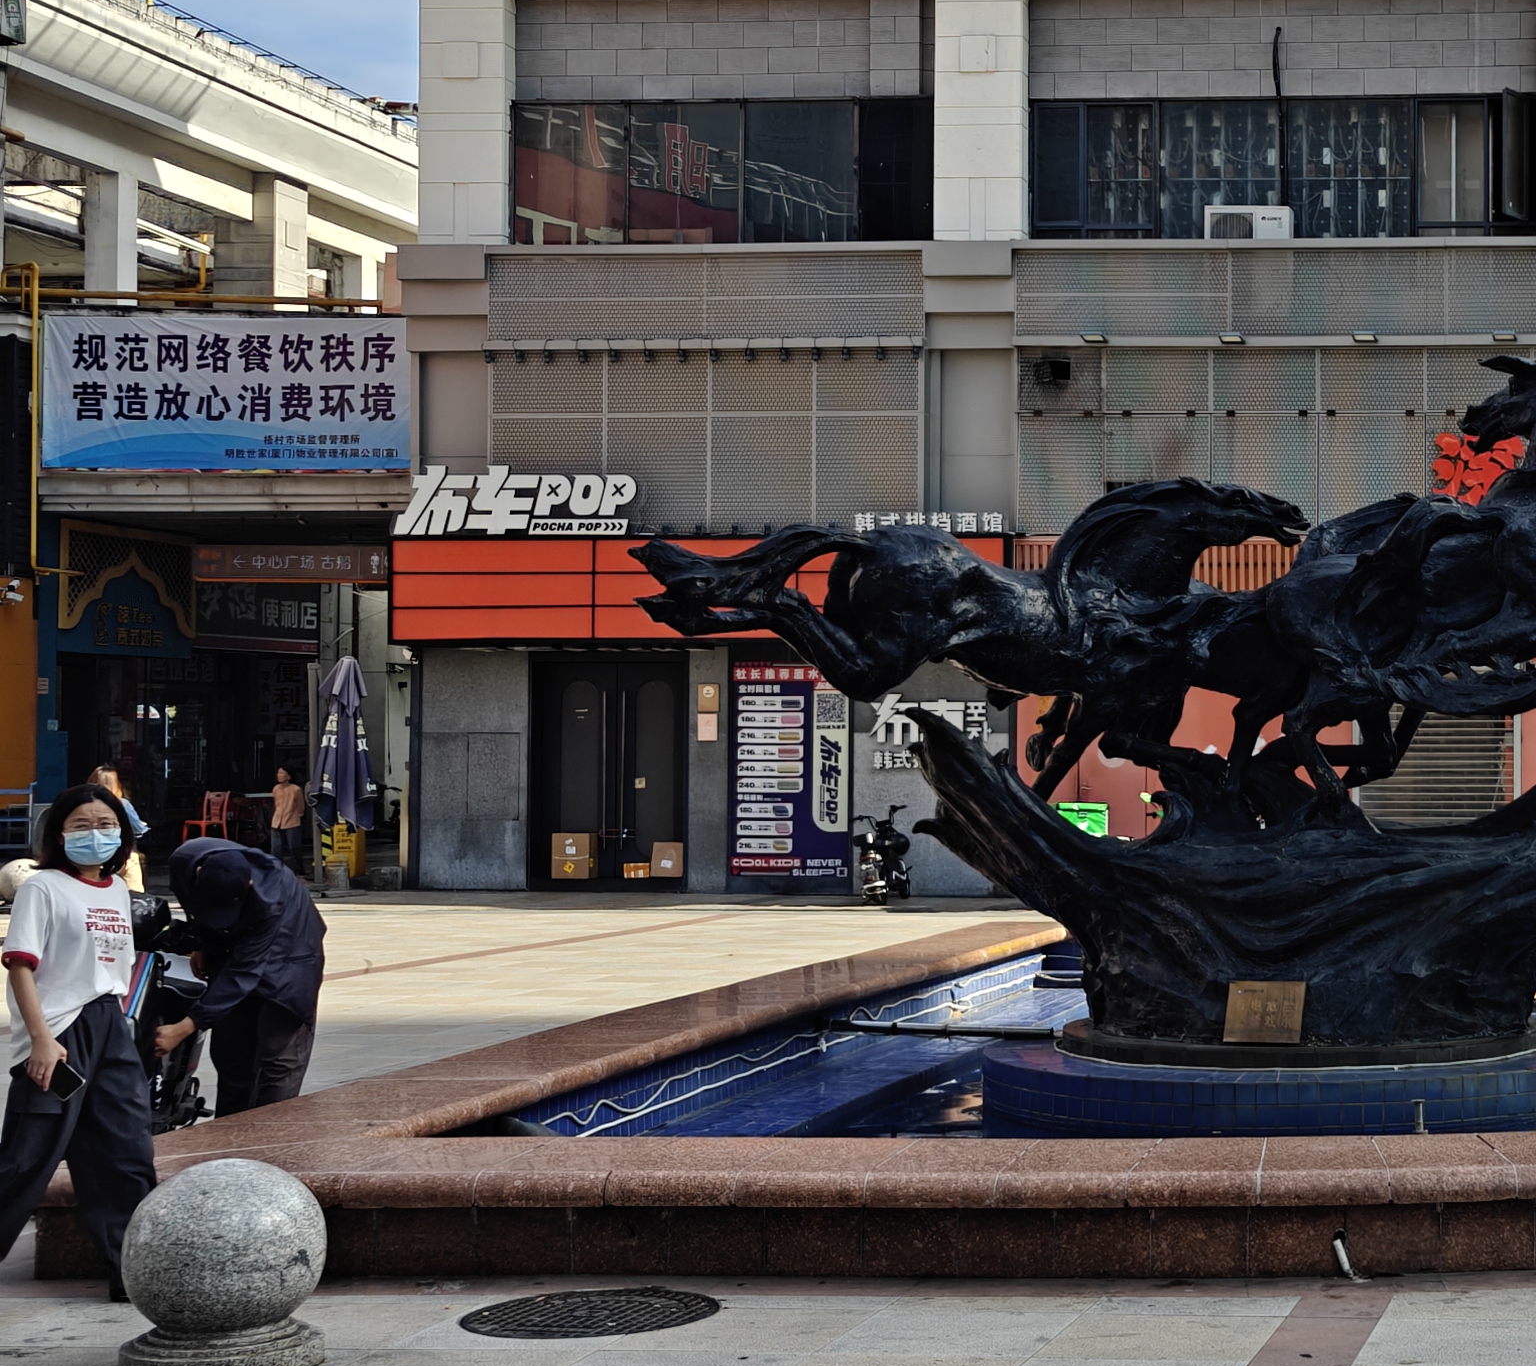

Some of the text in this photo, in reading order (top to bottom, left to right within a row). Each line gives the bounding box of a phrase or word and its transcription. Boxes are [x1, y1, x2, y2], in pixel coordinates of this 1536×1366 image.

[72, 333, 396, 373] 规范网络餐饮秩序
[72, 382, 396, 423] 营造放心消费环境
[263, 434, 361, 445] 梧村市场监督管理所
[532, 522, 602, 532] POCHA POP
[854, 511, 1004, 533] 韩式排档酒馆
[252, 554, 352, 570] 中心广场 古船
[262, 598, 318, 630] 便利店
[873, 750, 920, 770] 韩式
[806, 858, 843, 867] NEVER
[792, 868, 836, 877] SLEEP
